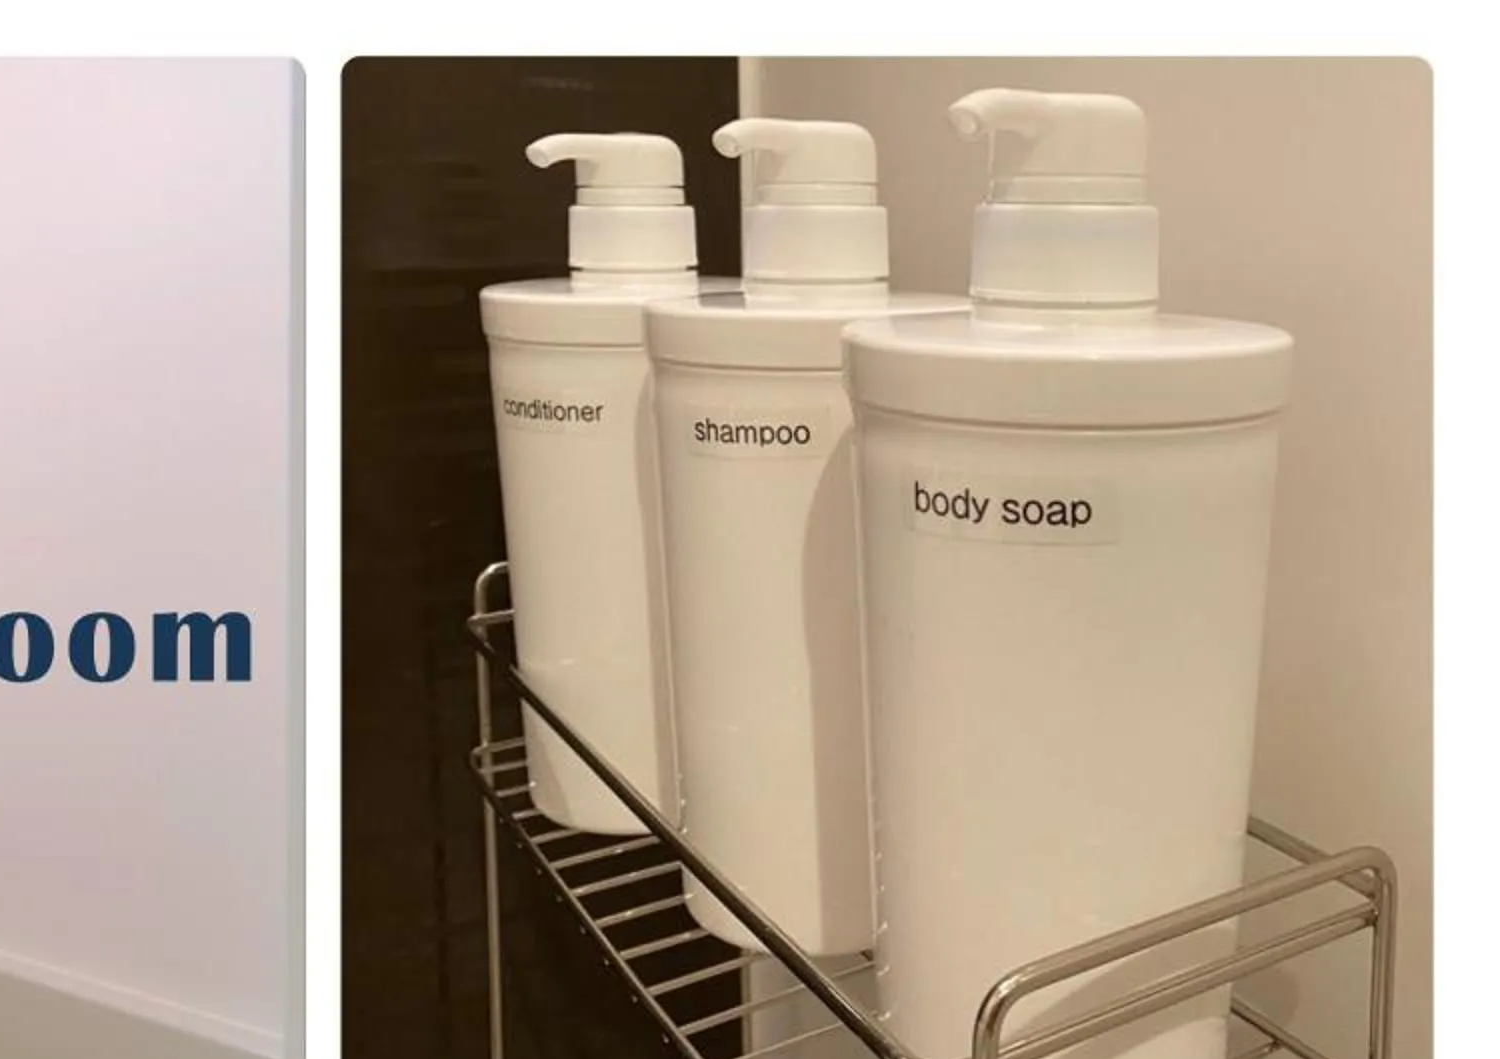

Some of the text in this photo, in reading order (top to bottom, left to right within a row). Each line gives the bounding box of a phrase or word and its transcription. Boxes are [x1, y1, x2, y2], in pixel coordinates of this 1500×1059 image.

[503, 398, 604, 424] conditioner
[694, 417, 812, 447] shampoo
[914, 481, 1093, 528] body soap
